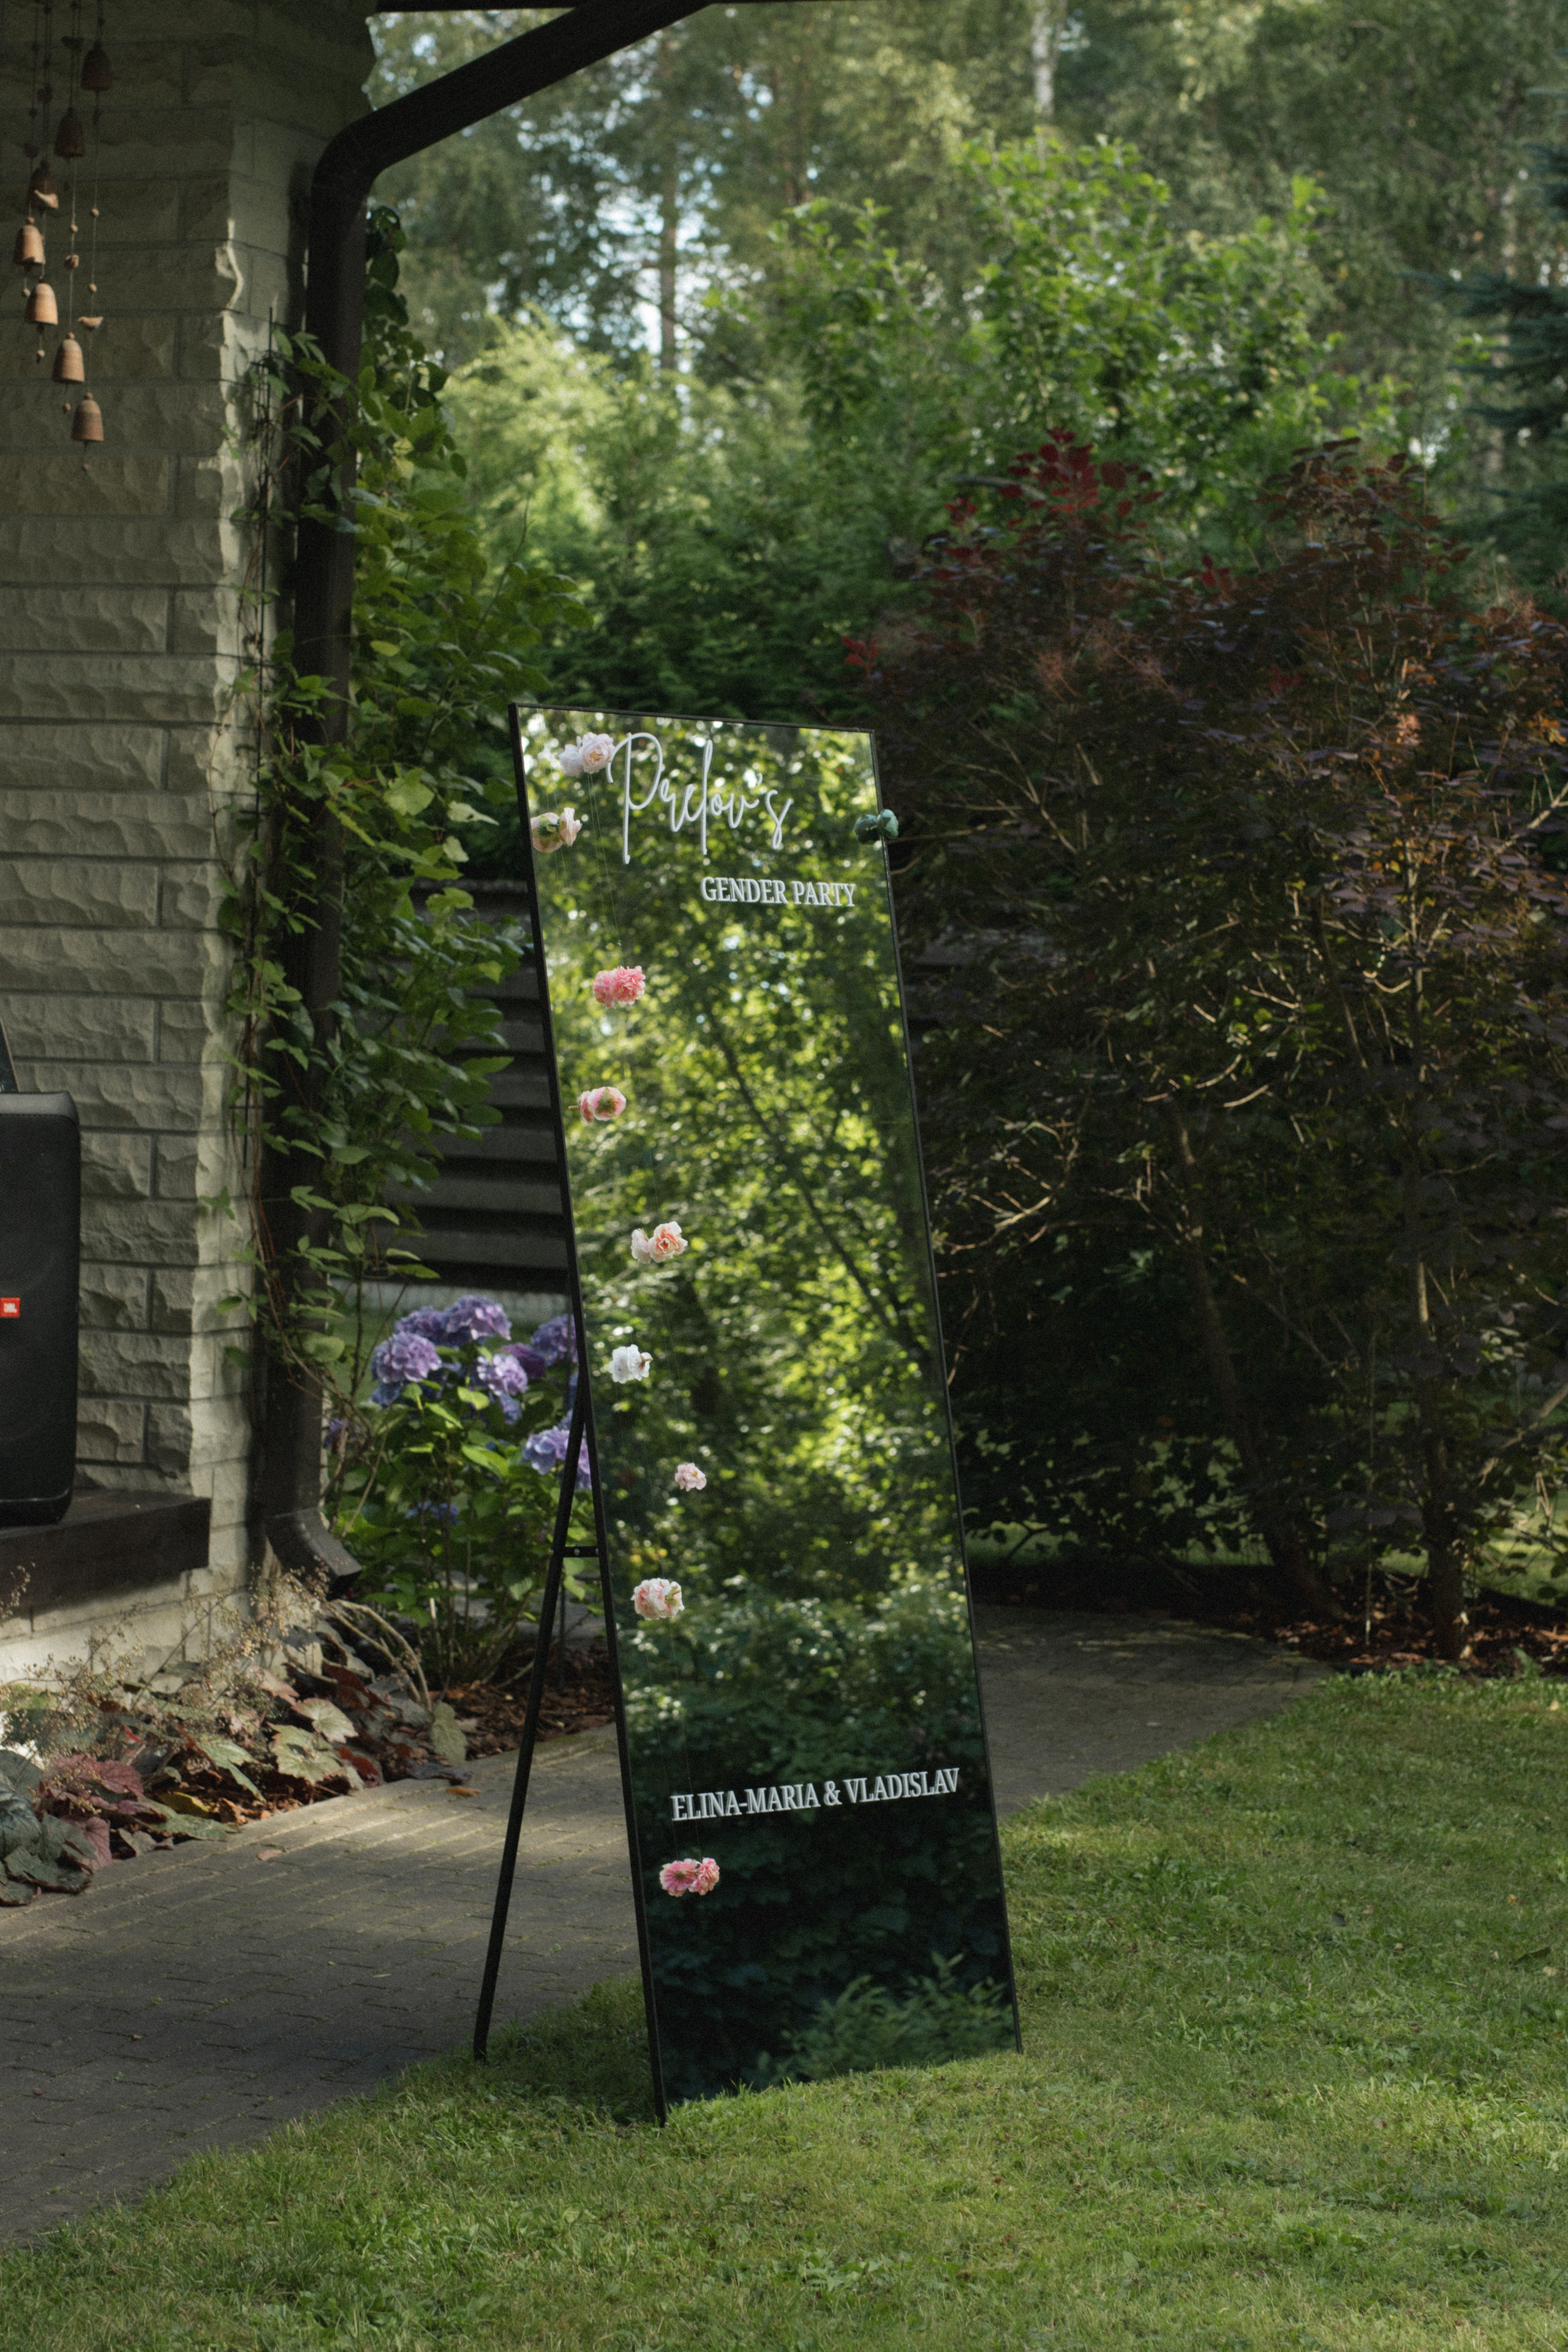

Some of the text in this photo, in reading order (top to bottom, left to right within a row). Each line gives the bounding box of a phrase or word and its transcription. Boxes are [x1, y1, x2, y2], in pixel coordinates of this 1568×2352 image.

[701, 876, 856, 907] GENDER PARTY
[670, 1767, 960, 1821] ELINA-MARIA & VLADISLAV
